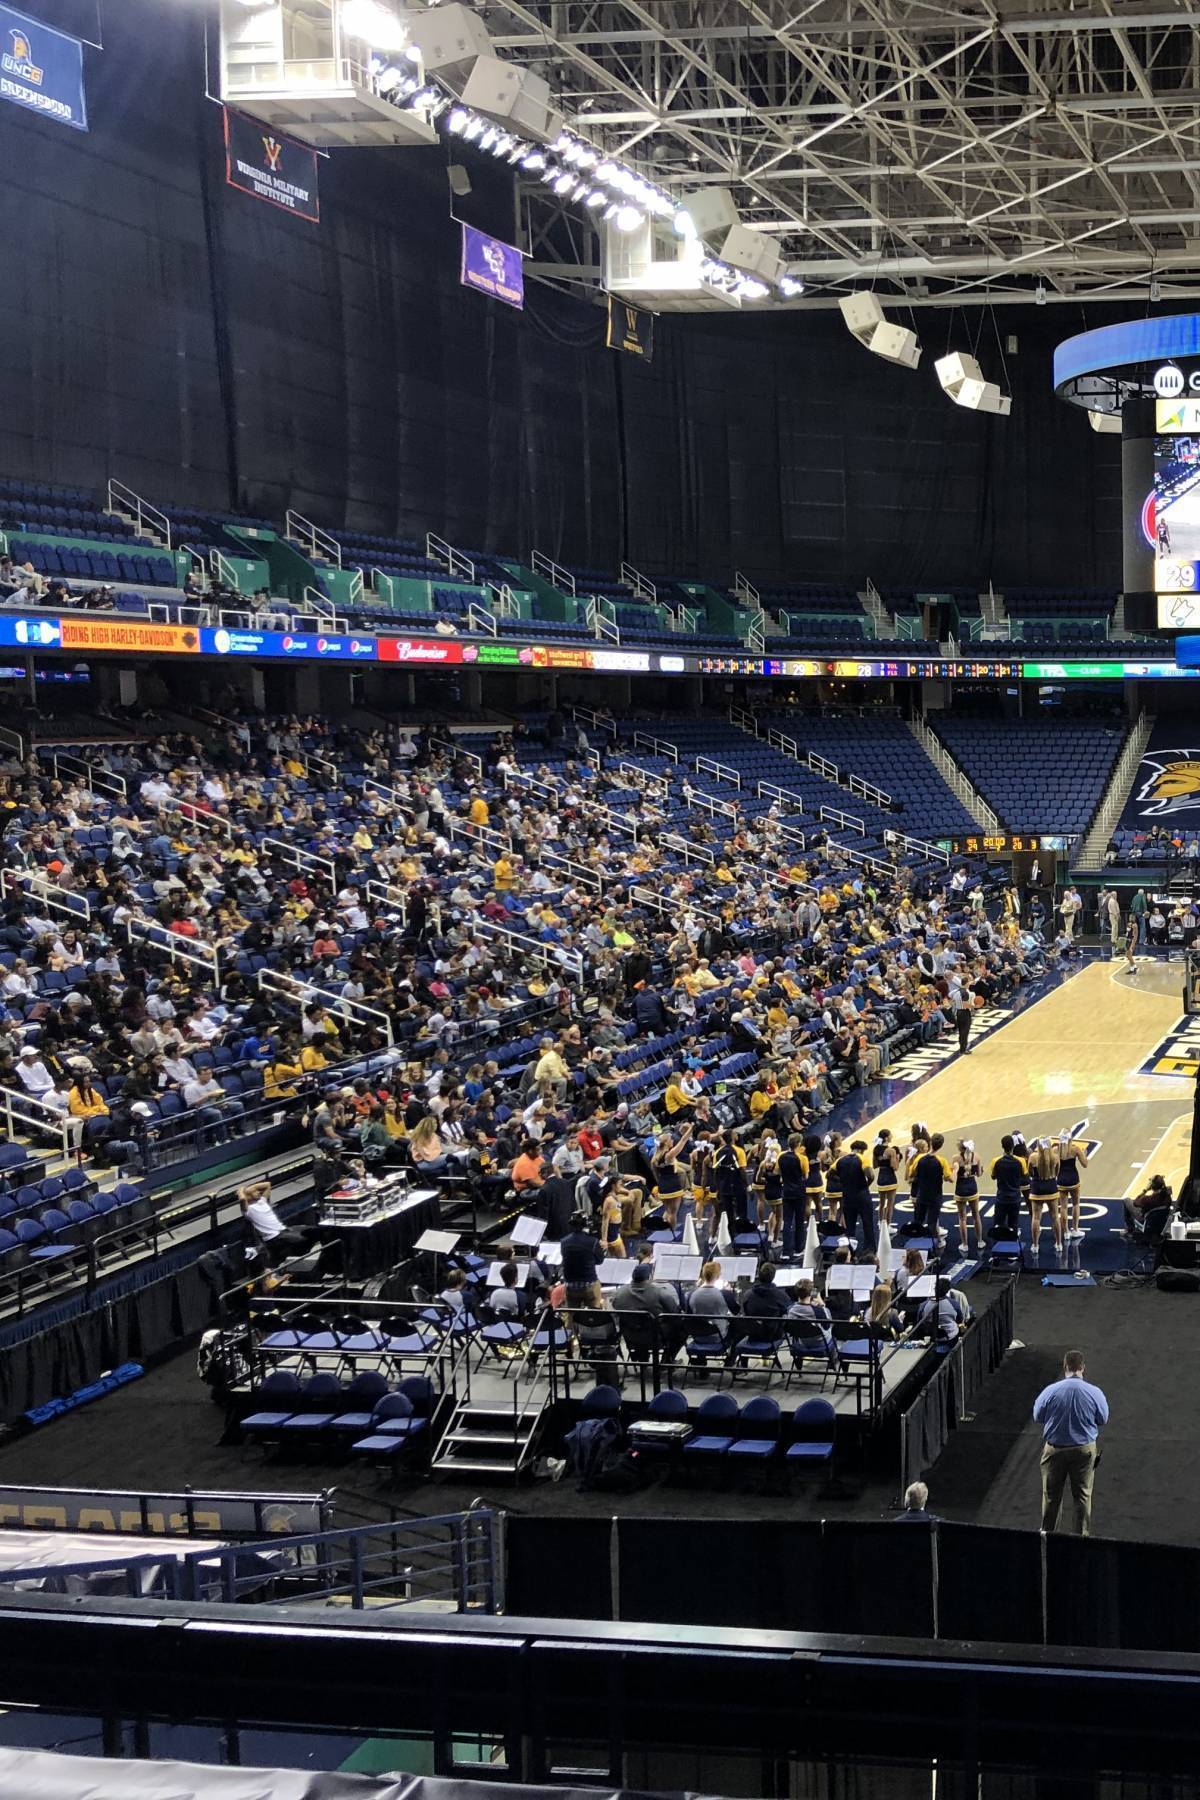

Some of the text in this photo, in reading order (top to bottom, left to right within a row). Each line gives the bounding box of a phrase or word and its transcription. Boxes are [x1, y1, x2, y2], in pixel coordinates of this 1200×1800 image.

[4, 56, 41, 81] UNCG
[237, 160, 309, 202] VIRGINIA MILITARY
[254, 181, 295, 207] INSTITUTE
[1166, 566, 1195, 587] 29
[63, 626, 89, 643] RIDING
[91, 627, 109, 643] HIGH
[397, 642, 448, 660] Budweiser
[793, 664, 805, 675] 29
[857, 665, 872, 676] 28
[968, 843, 978, 852] 29
